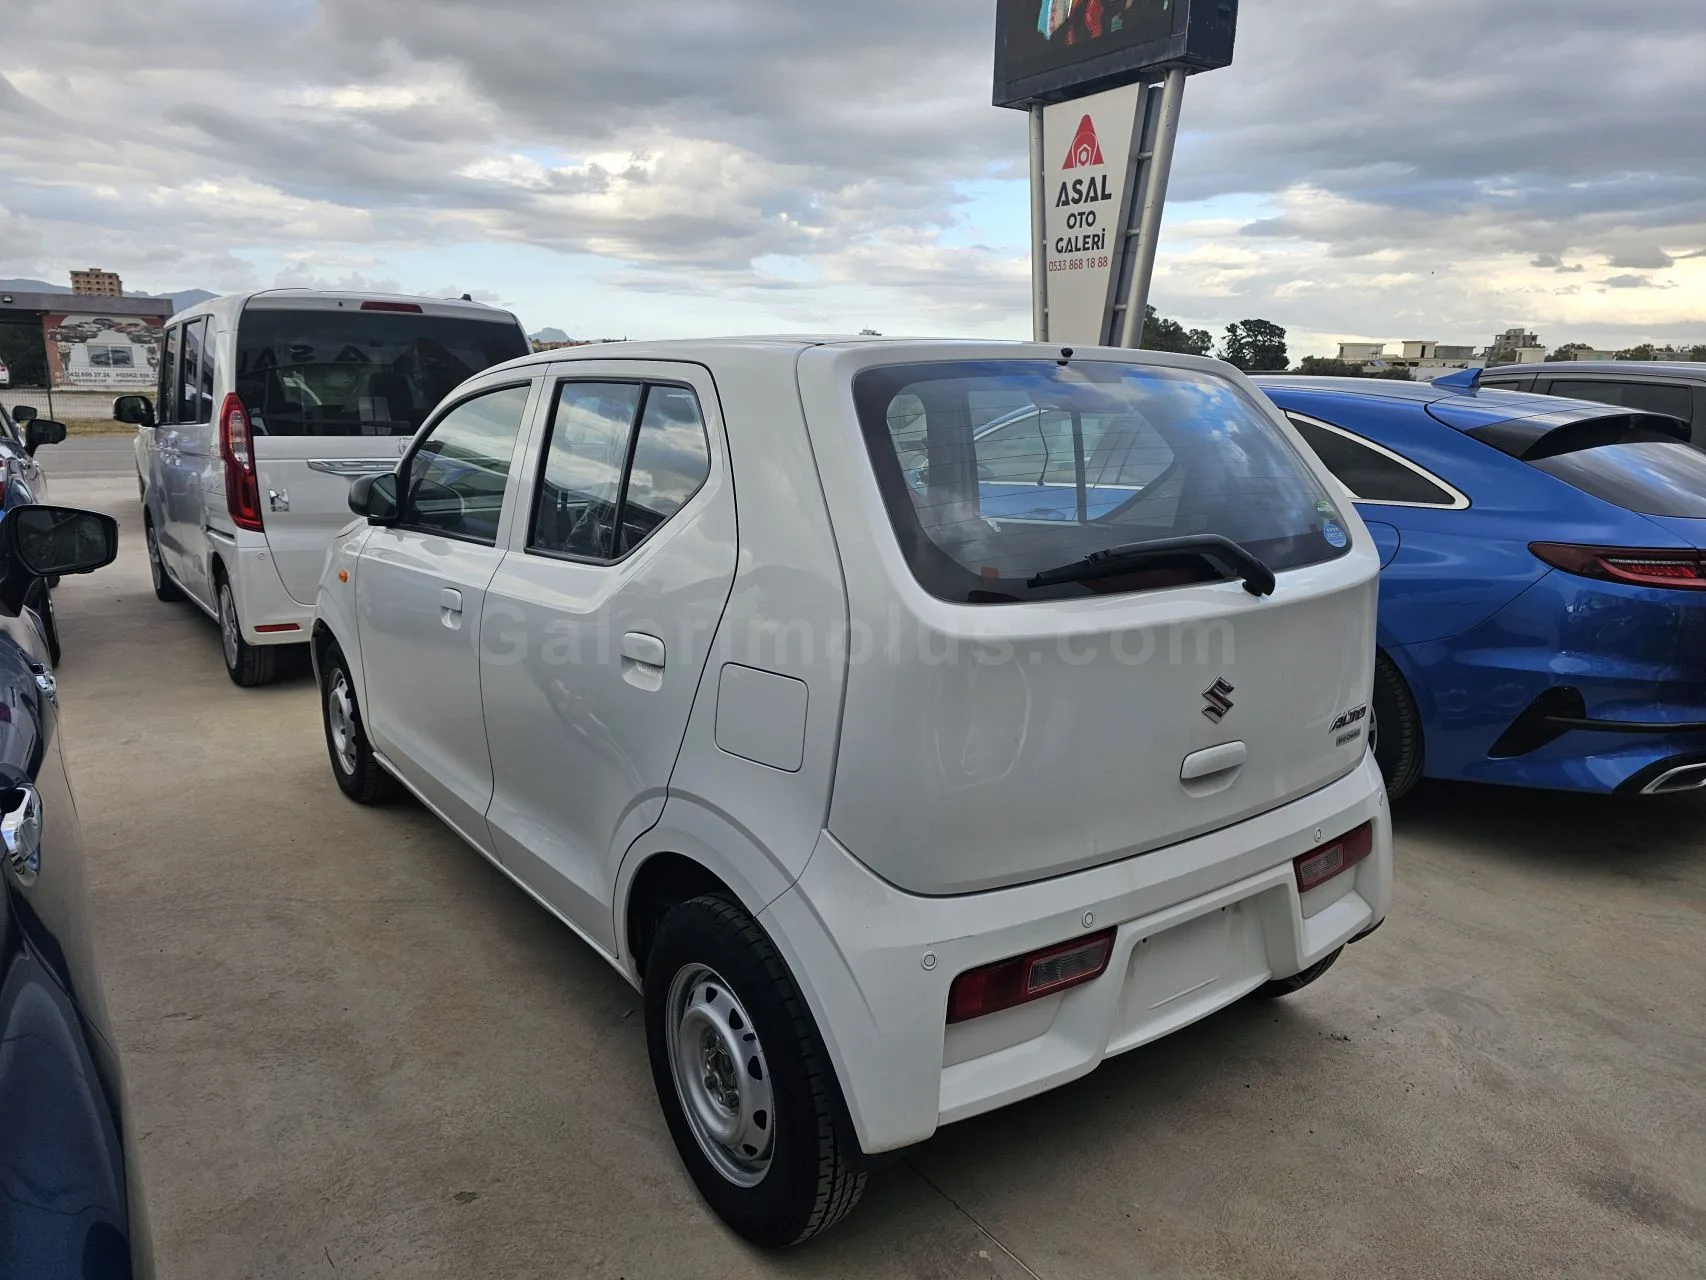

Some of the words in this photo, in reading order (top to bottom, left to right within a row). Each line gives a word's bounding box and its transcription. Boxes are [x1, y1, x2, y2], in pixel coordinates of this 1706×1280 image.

[1055, 174, 1112, 207] ASAL
[1066, 210, 1096, 229] OTO
[1055, 228, 1106, 253] GALERİ
[1048, 260, 1067, 272] 0533
[1068, 259, 1083, 270] 868
[1086, 257, 1096, 269] 18
[1097, 256, 1108, 268] 88
